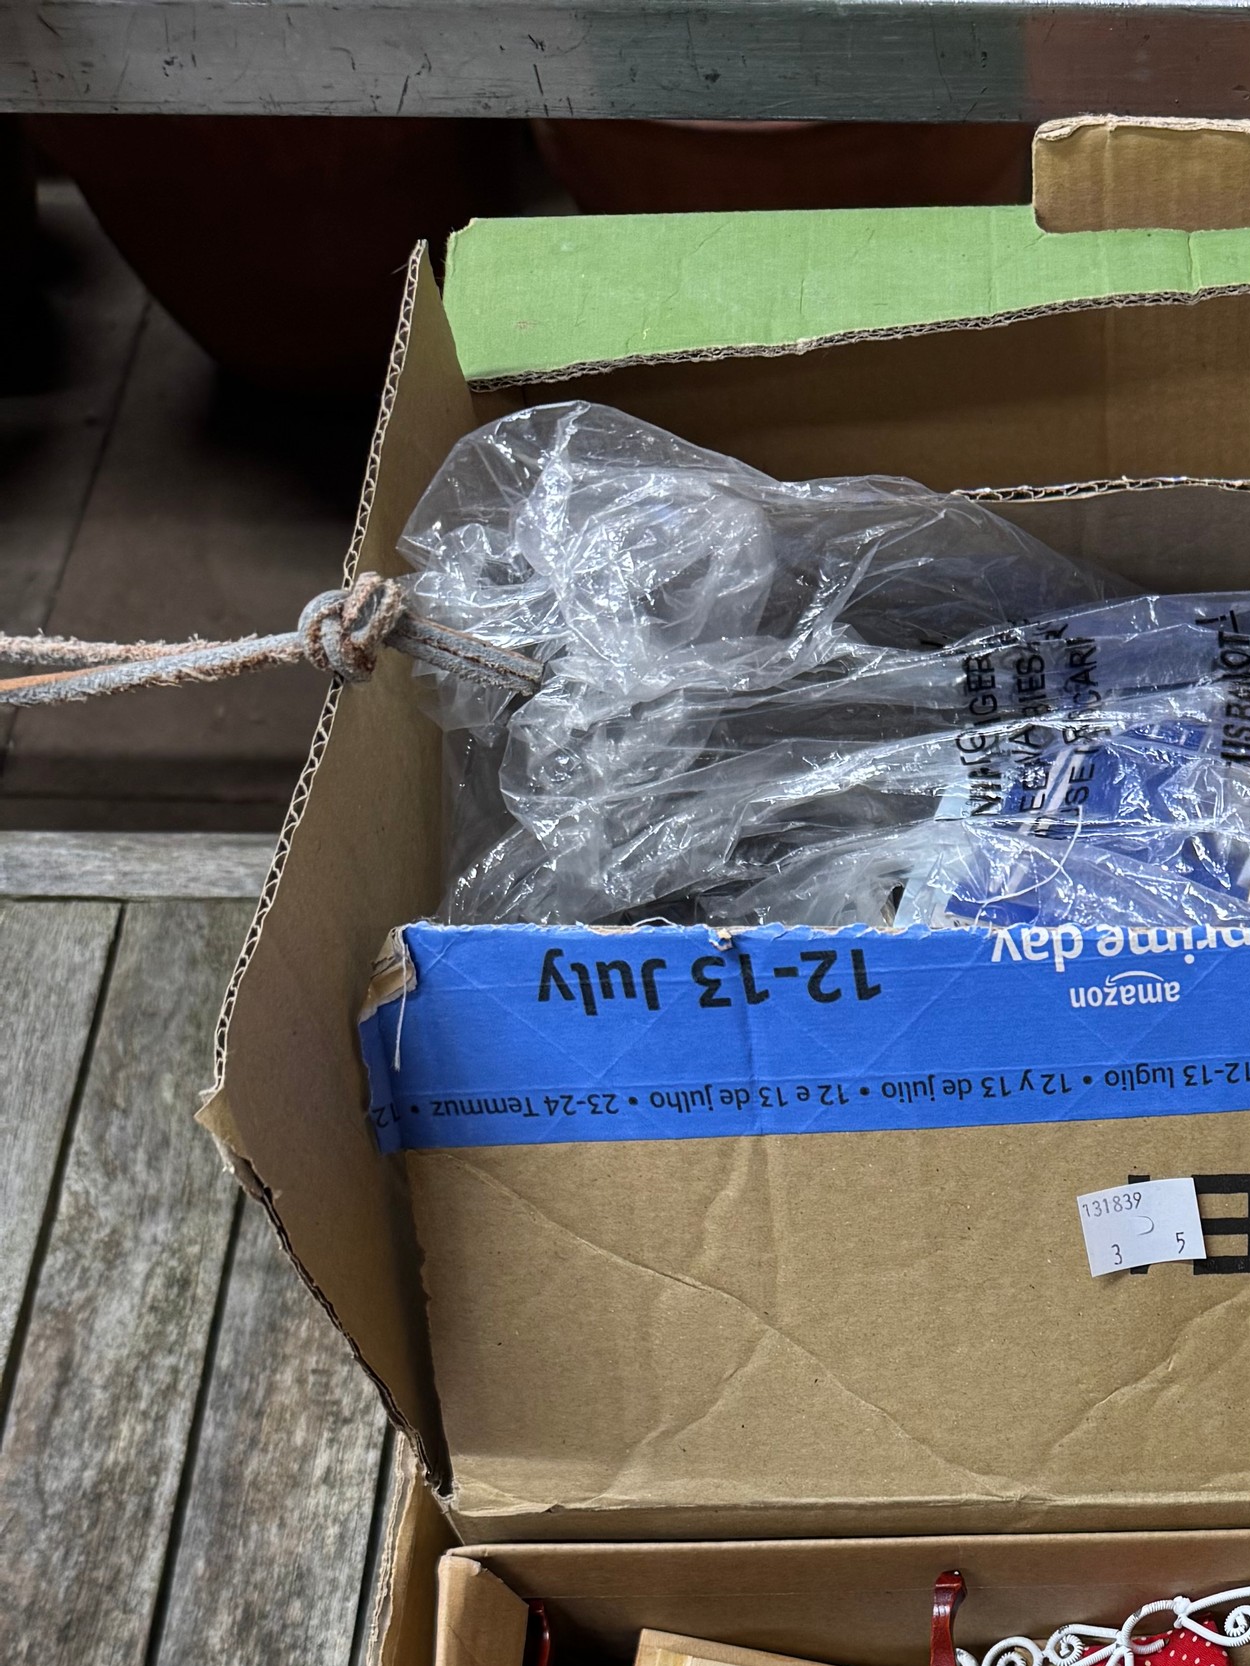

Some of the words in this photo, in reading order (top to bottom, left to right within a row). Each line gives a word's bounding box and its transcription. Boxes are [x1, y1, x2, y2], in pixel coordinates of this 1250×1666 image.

[538, 948, 668, 1016] July
[691, 948, 882, 1007] 12-13
[1069, 979, 1181, 1009] amazon
[981, 1076, 1011, 1098] 13
[1020, 1069, 1034, 1091] y
[1042, 1073, 1071, 1095] 12
[1104, 1063, 1174, 1091] luglio
[650, 1085, 712, 1113] julho
[721, 1088, 750, 1111] de
[759, 1087, 787, 1107] 13
[798, 1086, 810, 1101] e
[819, 1085, 848, 1105] 12
[881, 1075, 935, 1103] julio
[943, 1079, 973, 1101] de
[431, 1096, 539, 1119] Temmuz
[544, 1093, 617, 1116] 23-24
[1082, 1191, 1142, 1218] 131839
[1110, 1243, 1123, 1266] 3
[1175, 1231, 1186, 1254] 5
